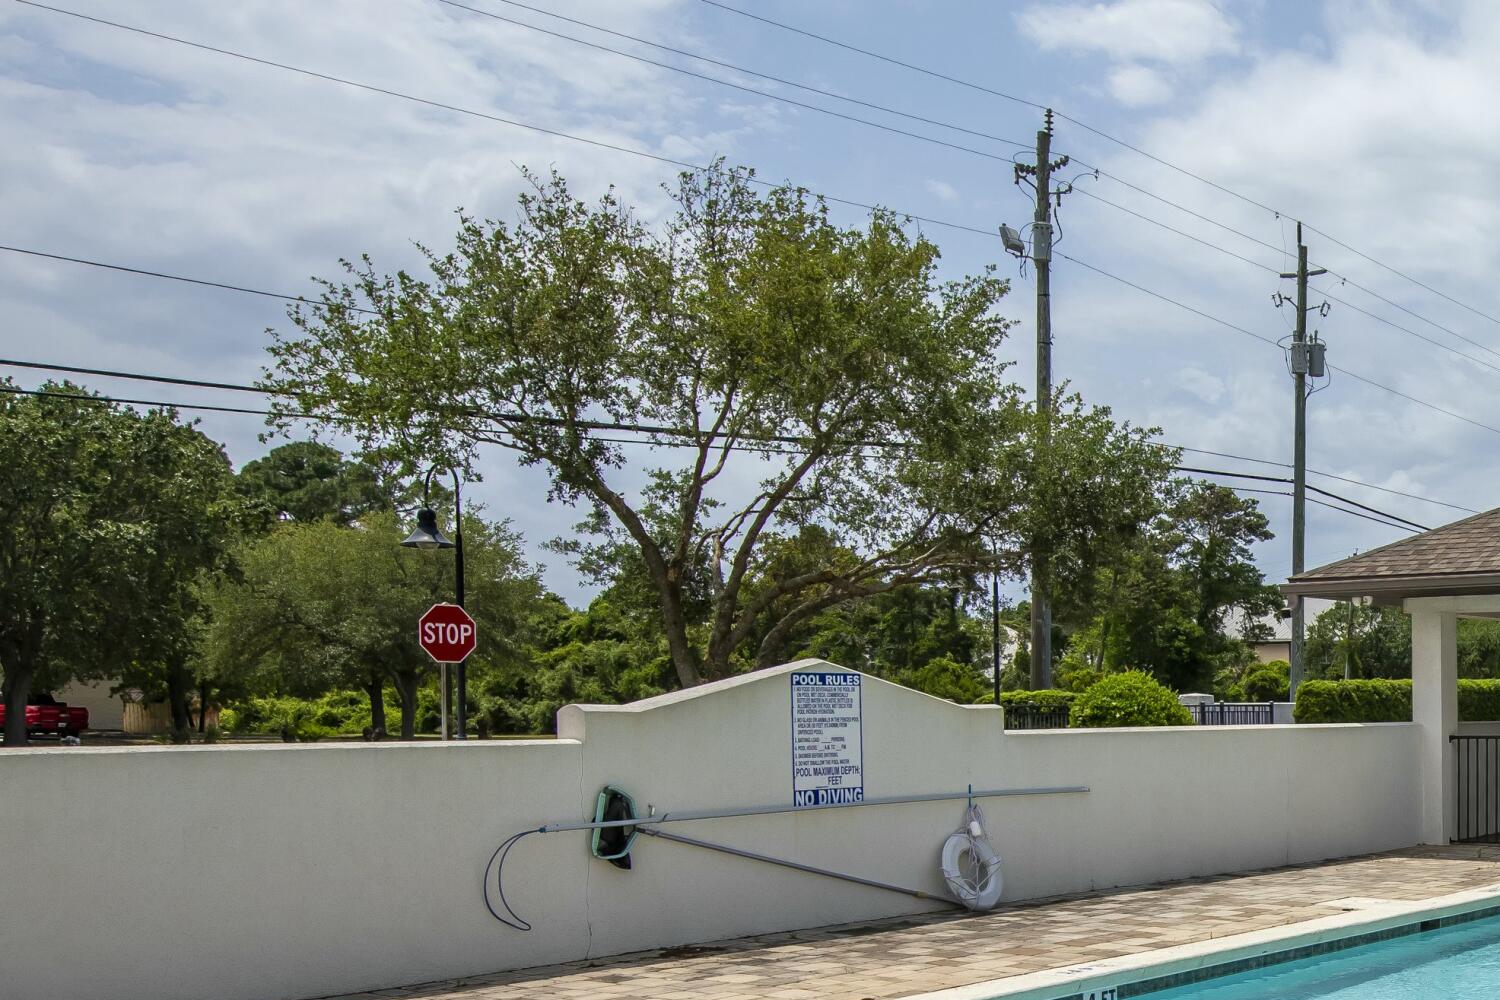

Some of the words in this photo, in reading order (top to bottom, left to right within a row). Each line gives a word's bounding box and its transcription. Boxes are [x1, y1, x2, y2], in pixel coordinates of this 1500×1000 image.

[424, 622, 472, 645] STOP
[792, 675, 822, 685] POOL
[825, 675, 860, 685] RULES
[796, 768, 812, 777] POOL
[828, 776, 842, 785] FEET
[795, 791, 815, 806] NO
[818, 788, 863, 804] DIVING
